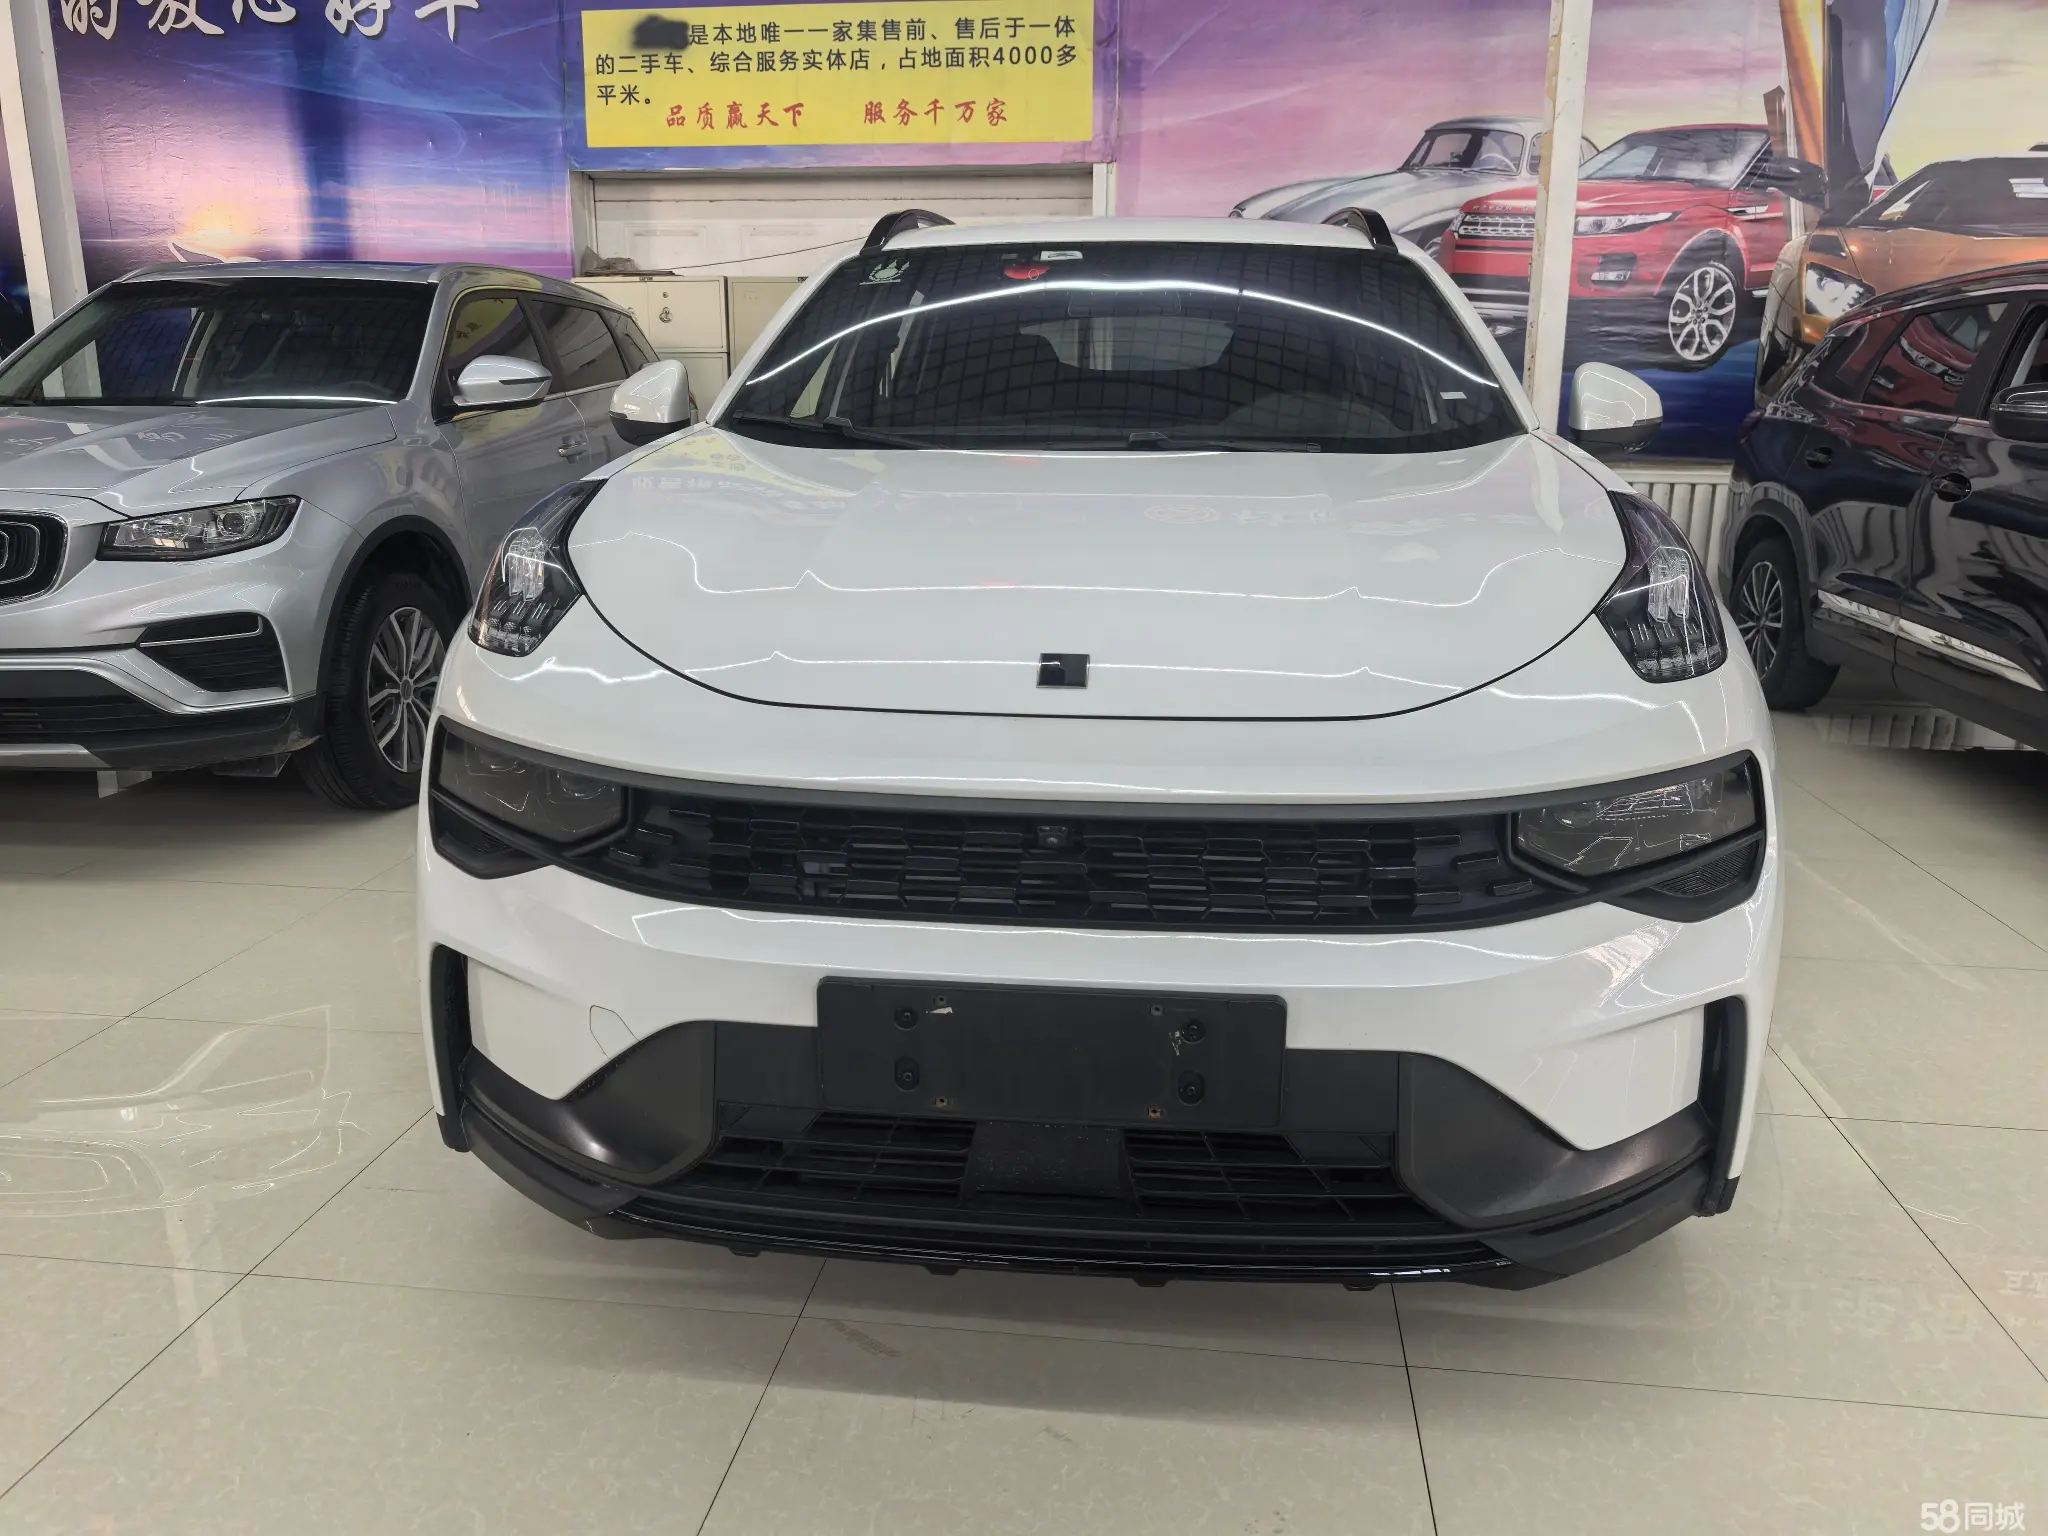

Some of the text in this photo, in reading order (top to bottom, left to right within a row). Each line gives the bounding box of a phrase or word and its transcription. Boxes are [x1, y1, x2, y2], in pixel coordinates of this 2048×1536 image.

[689, 15, 1077, 46] 是本地唯一一家集售前、售后于一体
[665, 97, 1008, 130] 品质赢天下 服务千万家
